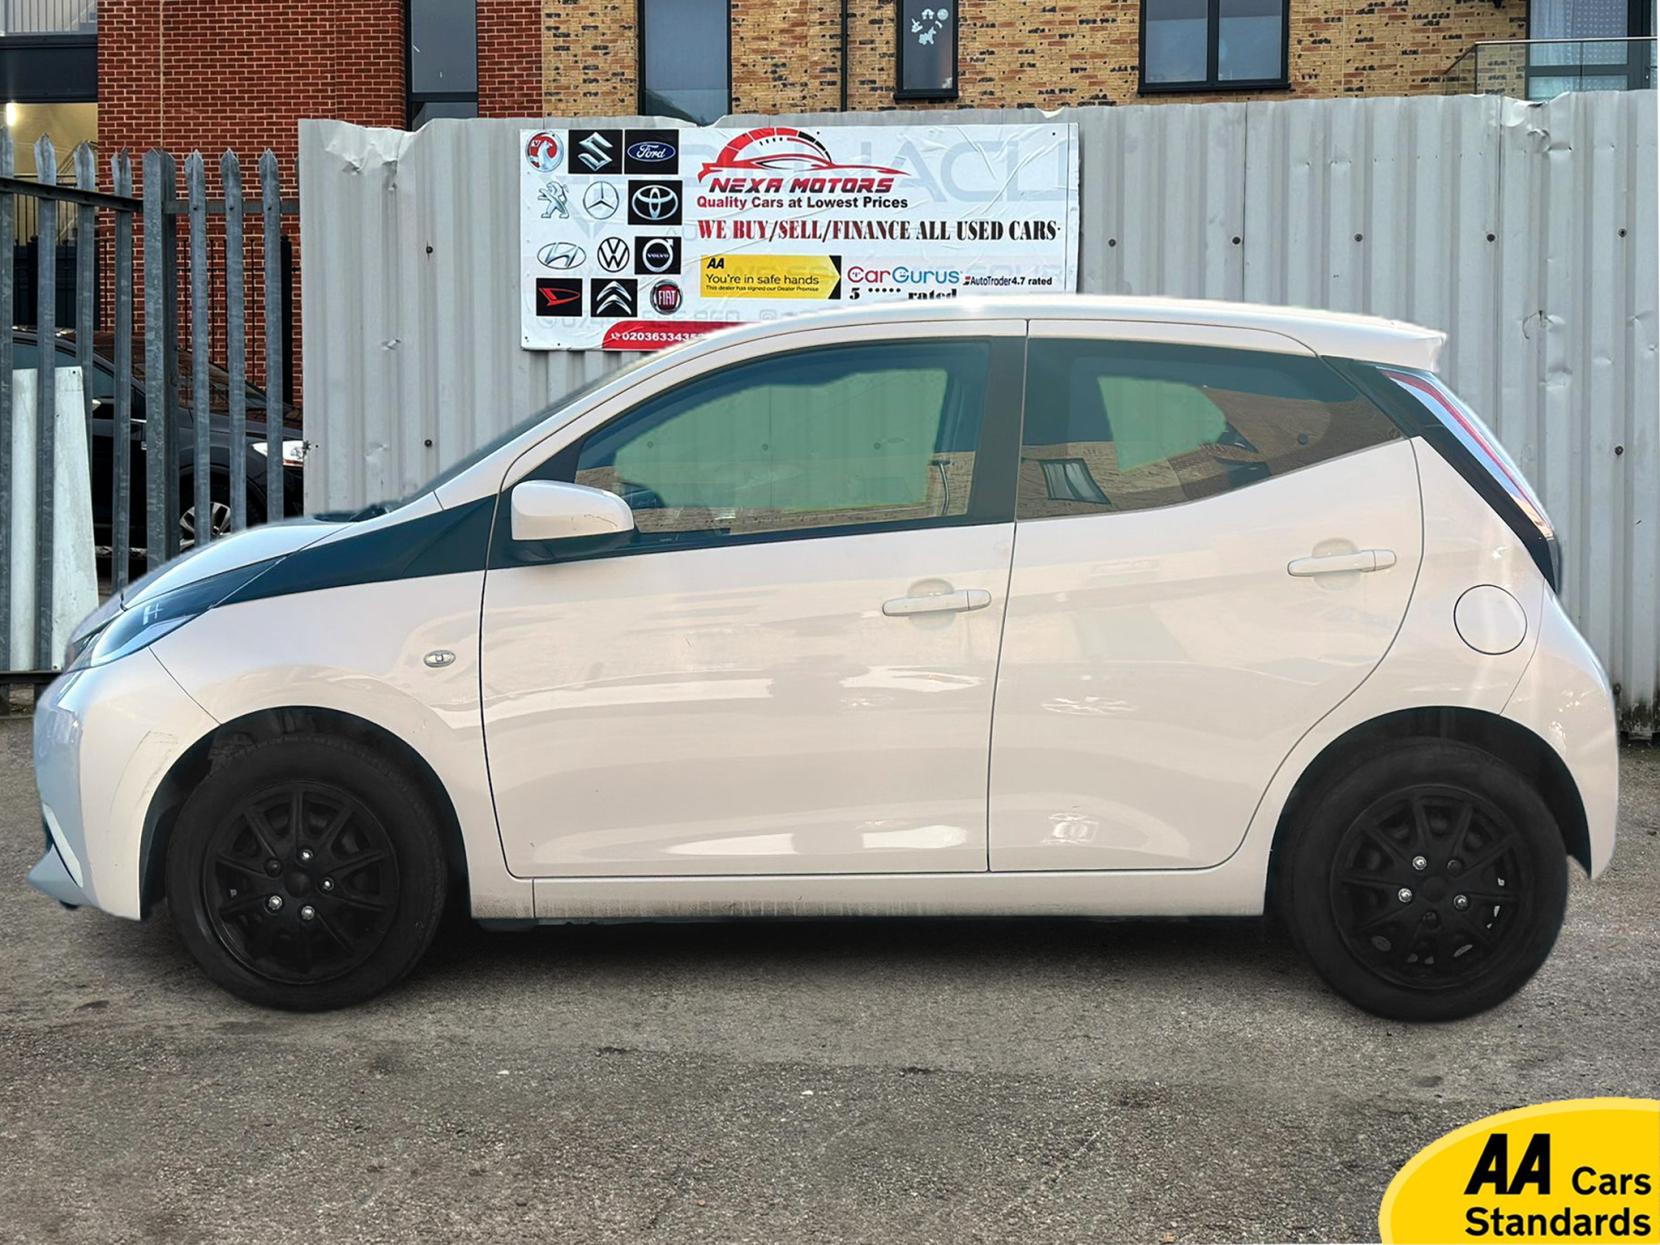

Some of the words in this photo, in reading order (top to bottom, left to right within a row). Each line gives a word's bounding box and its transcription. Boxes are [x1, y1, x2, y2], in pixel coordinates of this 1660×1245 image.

[636, 144, 666, 158] Ford
[709, 178, 784, 193] NEXA
[790, 178, 894, 193] MOTORS
[697, 196, 748, 210] Quality
[752, 196, 784, 208] Cars
[788, 197, 802, 208] at
[807, 196, 858, 208] Lowest
[863, 196, 908, 208] Prices
[697, 220, 726, 240] WE
[916, 221, 950, 240] ALL
[957, 221, 1004, 240] USED
[706, 258, 724, 269] AA
[706, 274, 741, 284] You're
[744, 274, 754, 284] in
[757, 274, 781, 284] safe
[784, 274, 820, 285] hands
[847, 266, 960, 284] CarGurus
[1028, 277, 1052, 286] rated
[658, 290, 676, 306] FIAT
[849, 287, 860, 300] 5
